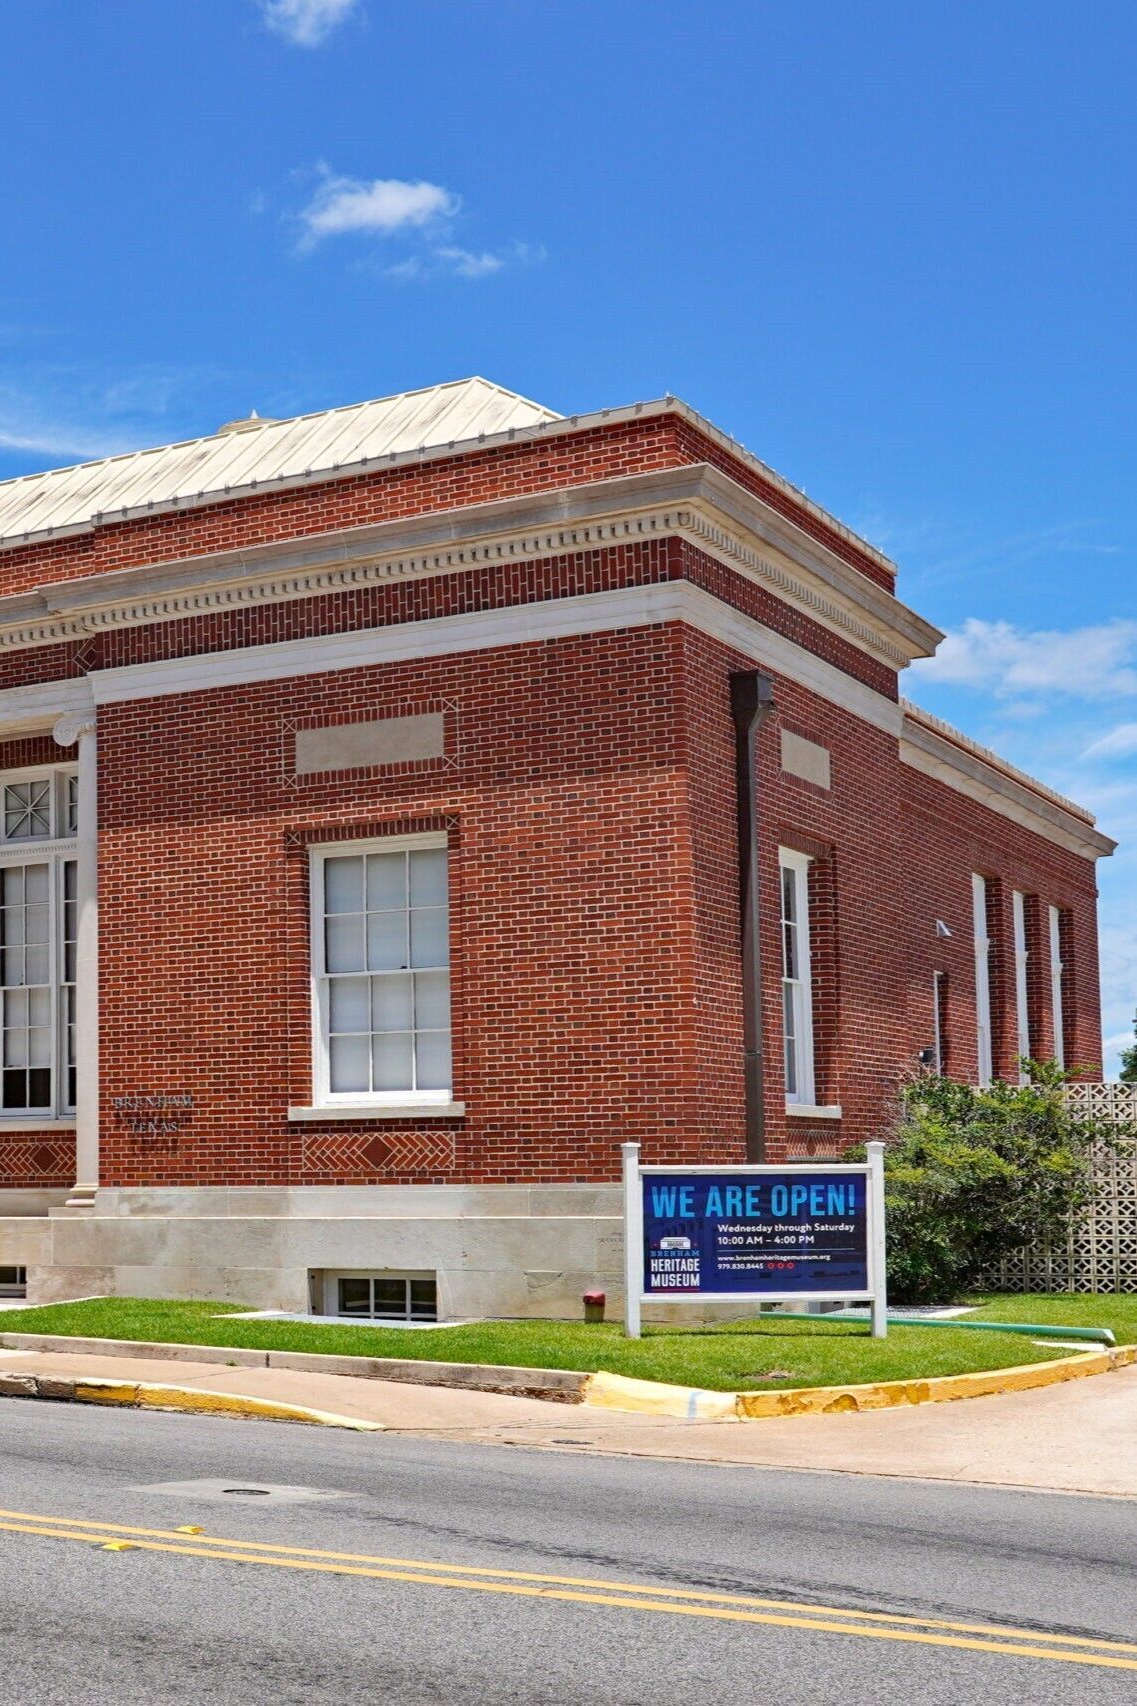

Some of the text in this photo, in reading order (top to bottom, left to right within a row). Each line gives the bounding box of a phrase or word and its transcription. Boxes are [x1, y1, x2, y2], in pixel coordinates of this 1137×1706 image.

[129, 1121, 179, 1133] TEXAS
[651, 1184, 855, 1218] WE ARE OPEN!
[717, 1222, 855, 1234] Wednesday through Saturday
[717, 1236, 744, 1245] 10:00
[746, 1236, 763, 1245] AM
[774, 1235, 796, 1244] 4:00
[798, 1235, 815, 1244] PM
[717, 1254, 831, 1262] www.brenhamheritagemuseum.org
[650, 1258, 700, 1272] HERITAGE
[650, 1273, 700, 1287] MUSEUM
